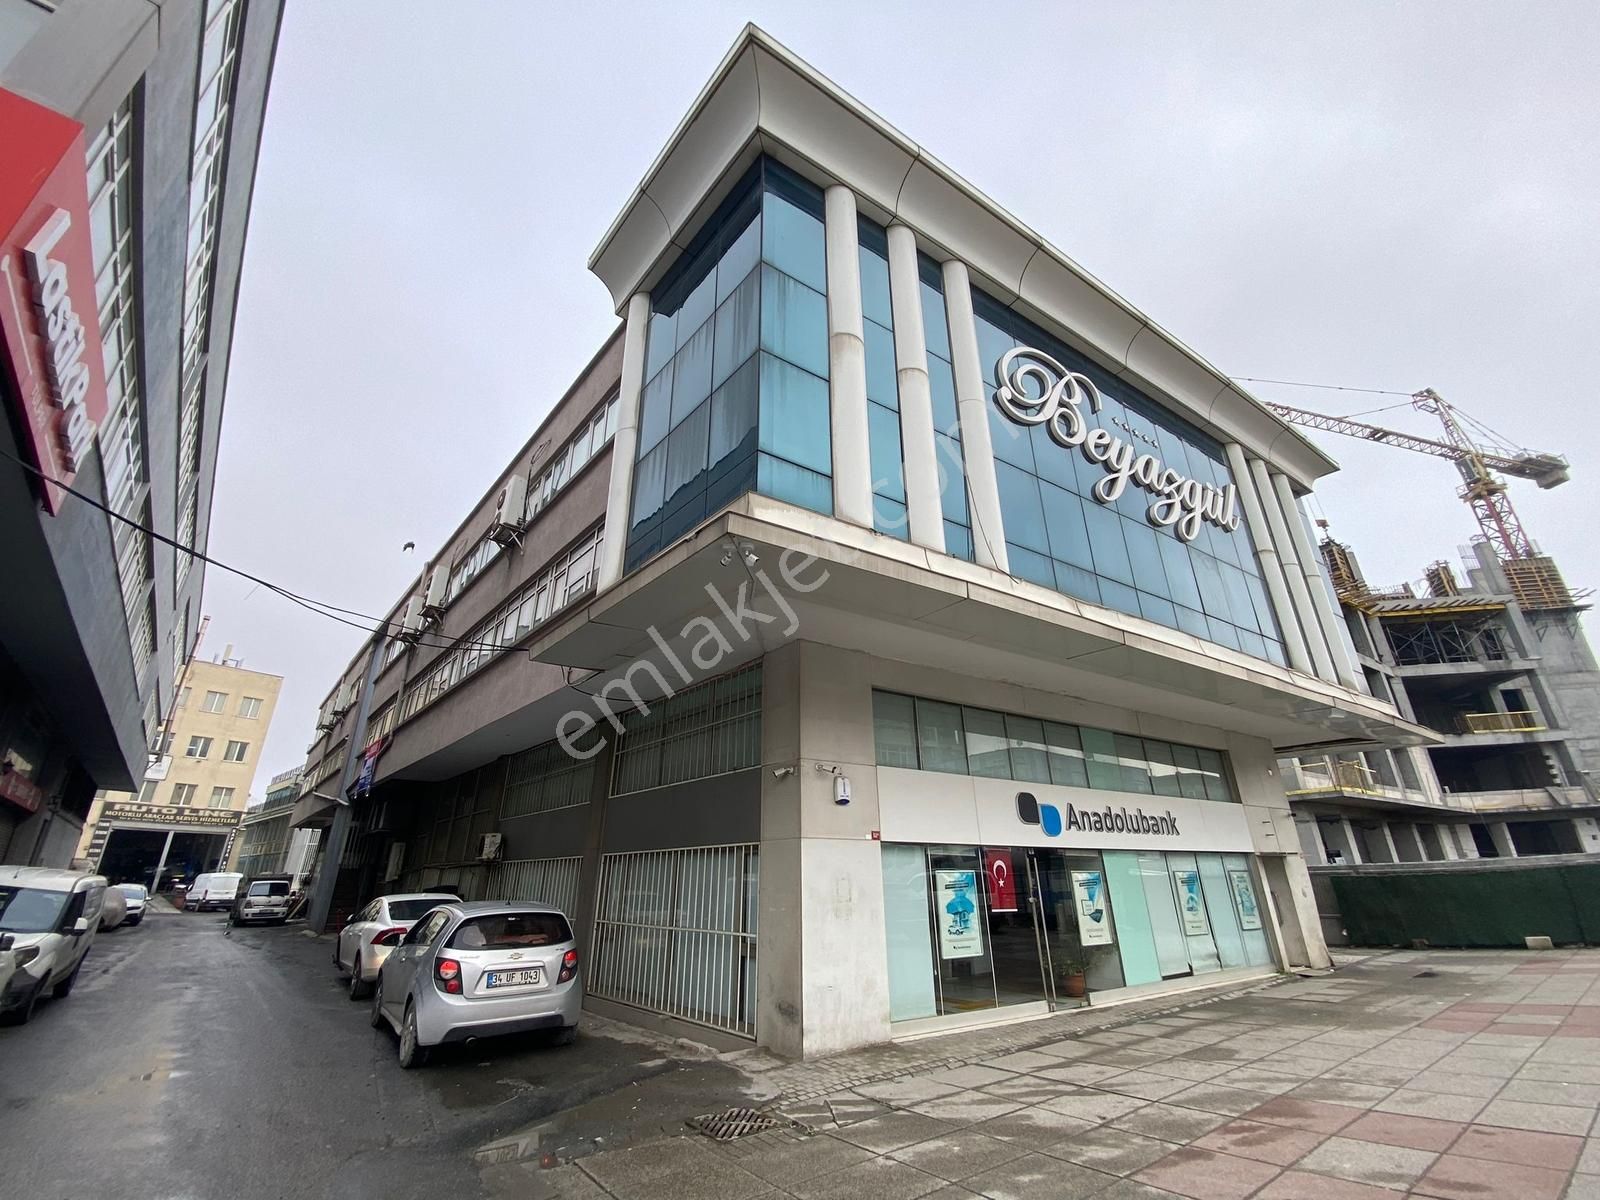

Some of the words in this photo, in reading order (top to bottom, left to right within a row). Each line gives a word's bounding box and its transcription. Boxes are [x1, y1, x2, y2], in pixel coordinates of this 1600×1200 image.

[993, 346, 1240, 541] Beyazgül
[105, 810, 142, 818] MOTORLU
[114, 804, 178, 814] AUTO
[1066, 803, 1180, 836] Anadolubank
[492, 974, 502, 984] 34
[506, 972, 516, 983] UF
[520, 970, 538, 981] 1043
